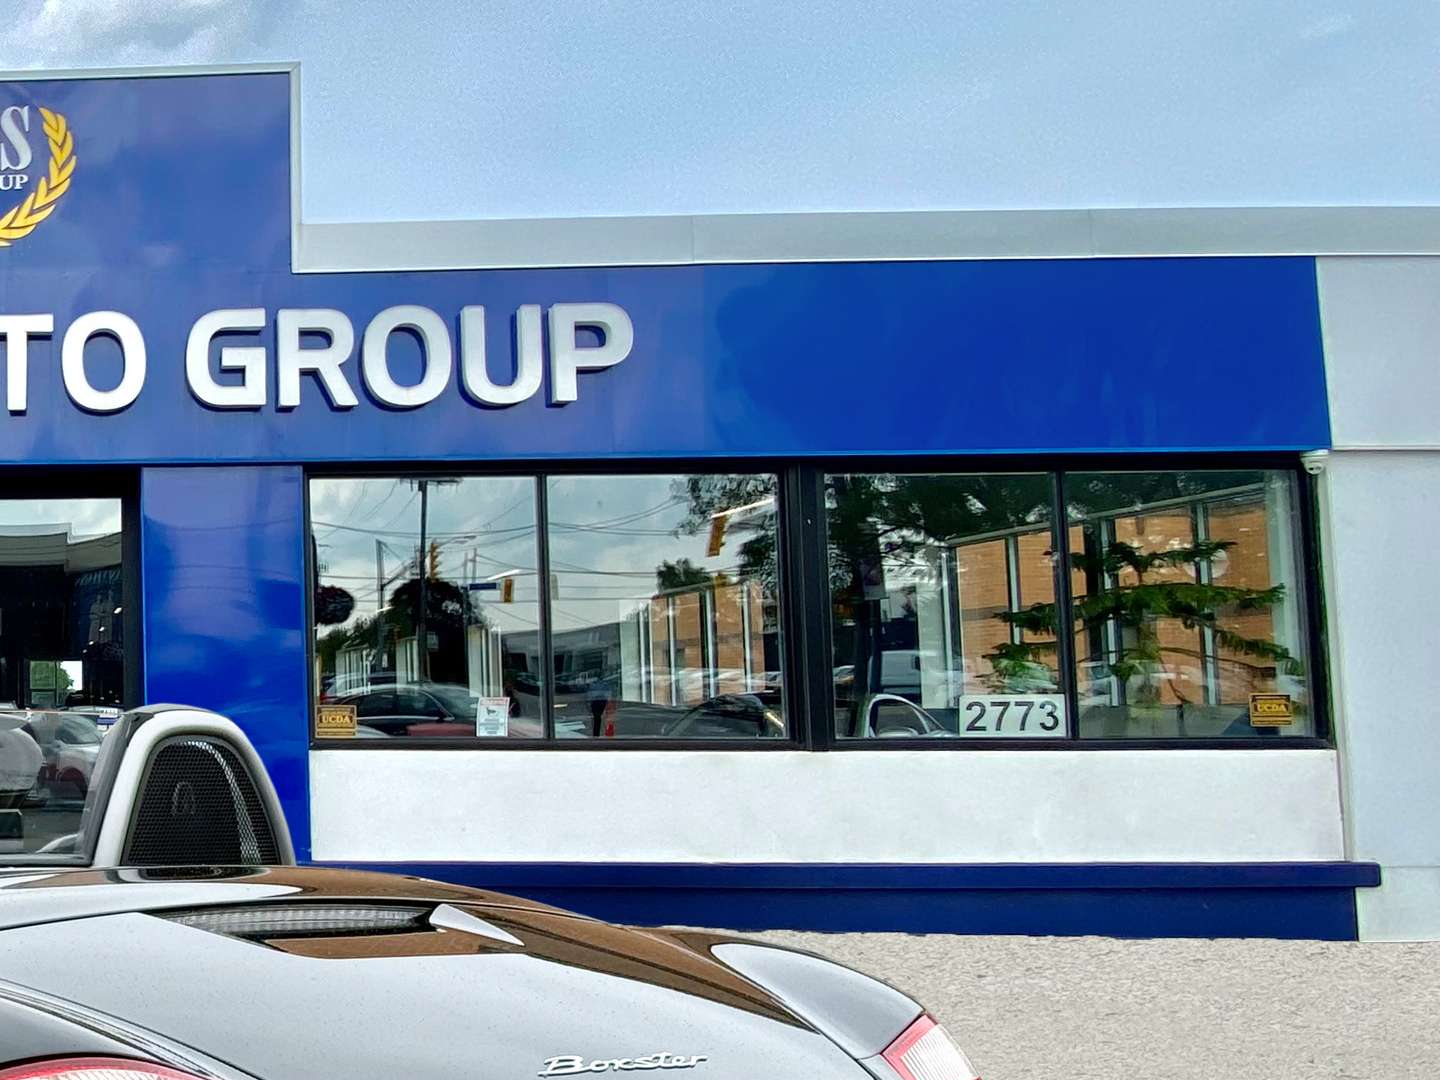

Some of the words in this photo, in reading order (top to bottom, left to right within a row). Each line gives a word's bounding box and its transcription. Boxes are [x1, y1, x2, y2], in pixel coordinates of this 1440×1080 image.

[185, 302, 635, 411] GROUP
[321, 714, 352, 724] UCDA
[965, 700, 1059, 732] 2773
[1256, 703, 1288, 713] UCDA
[537, 1052, 709, 1078] Boxster
